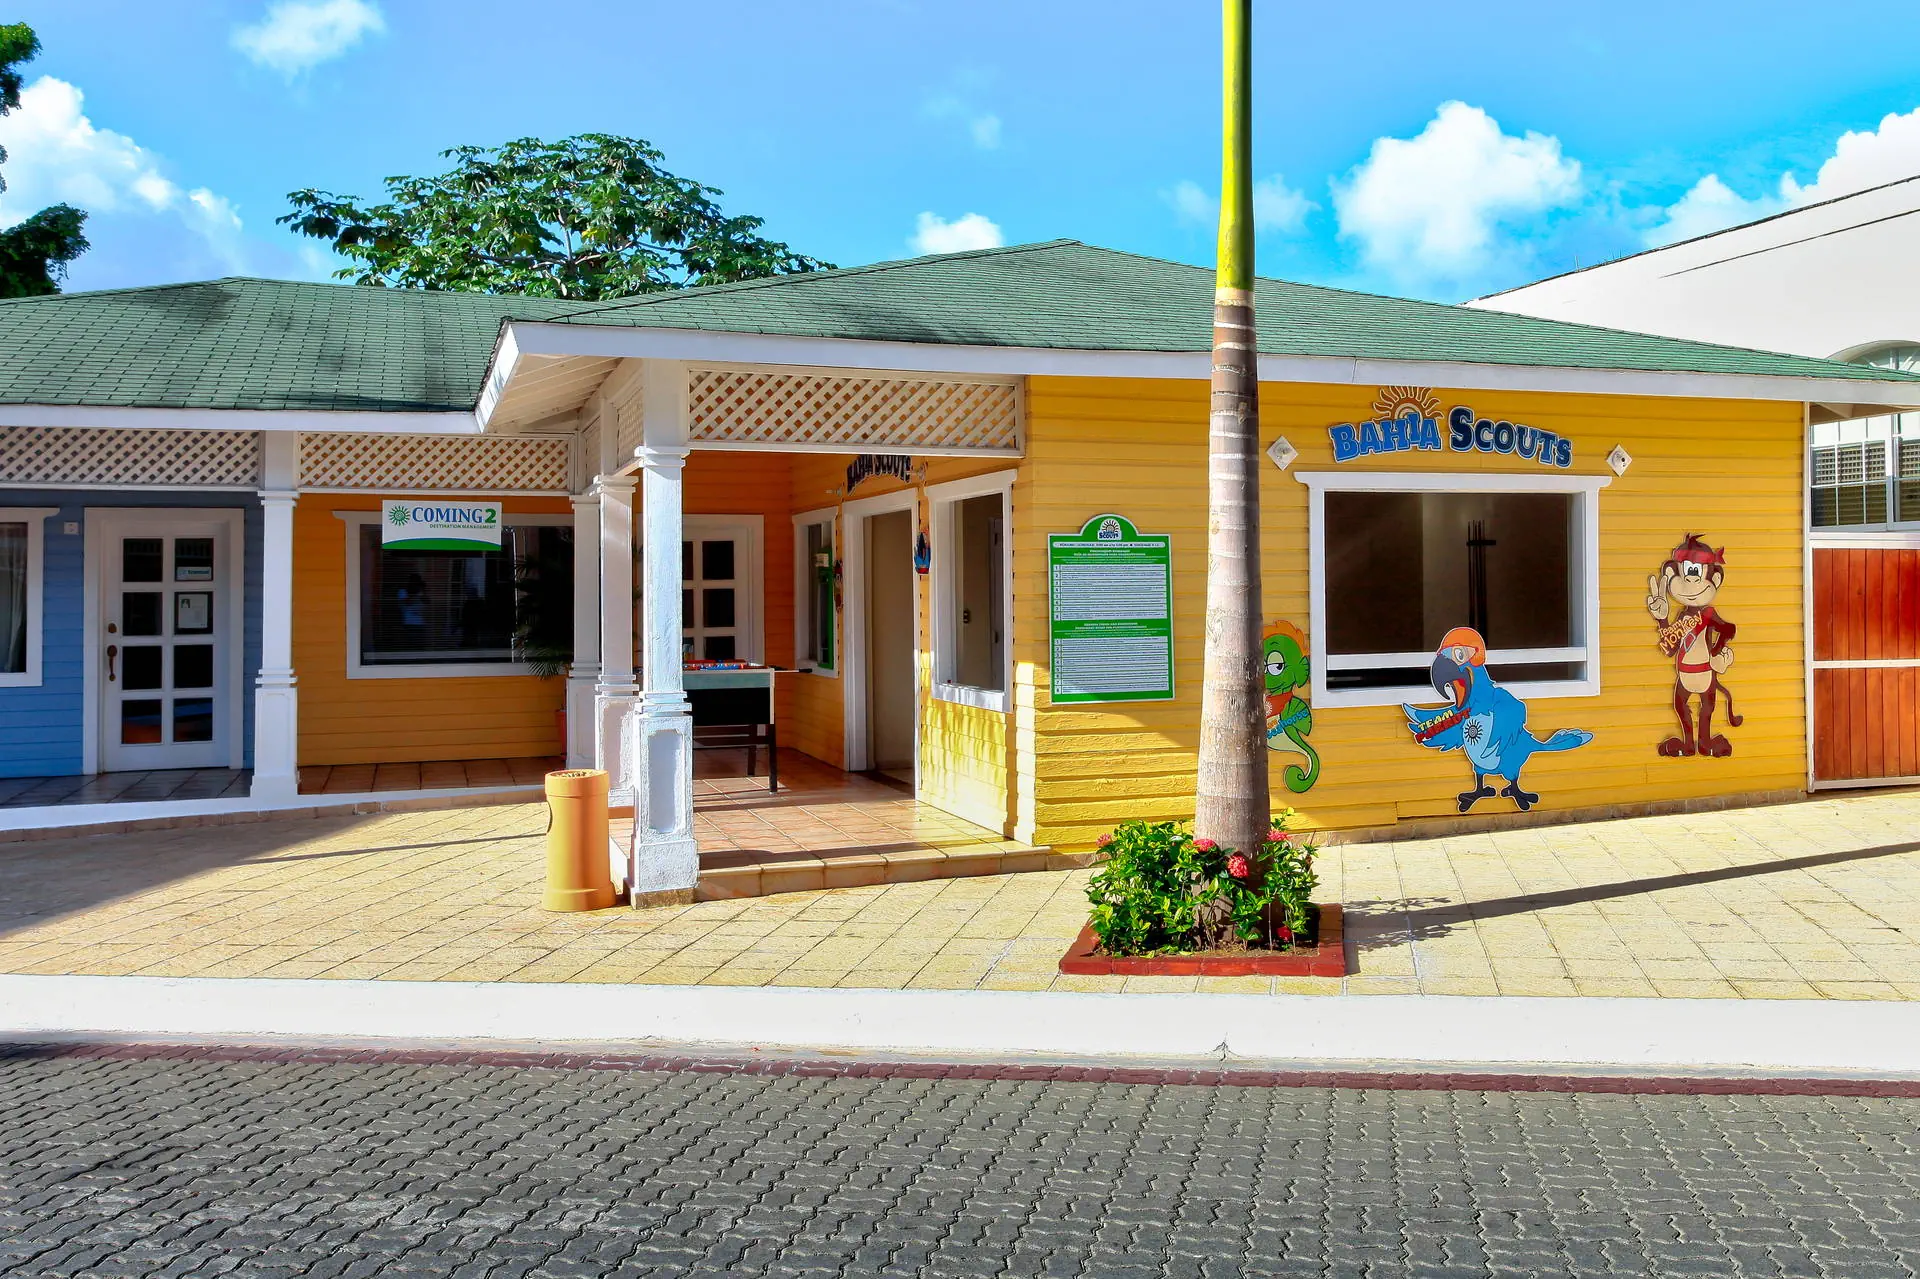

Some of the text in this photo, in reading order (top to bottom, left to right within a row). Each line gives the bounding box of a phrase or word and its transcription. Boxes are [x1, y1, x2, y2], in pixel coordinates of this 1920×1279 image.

[1330, 406, 1573, 468] BAHIA SCOUTS
[1658, 620, 1682, 639] Team
[1660, 610, 1703, 655] Monkey
[1417, 708, 1455, 732] TEAM
